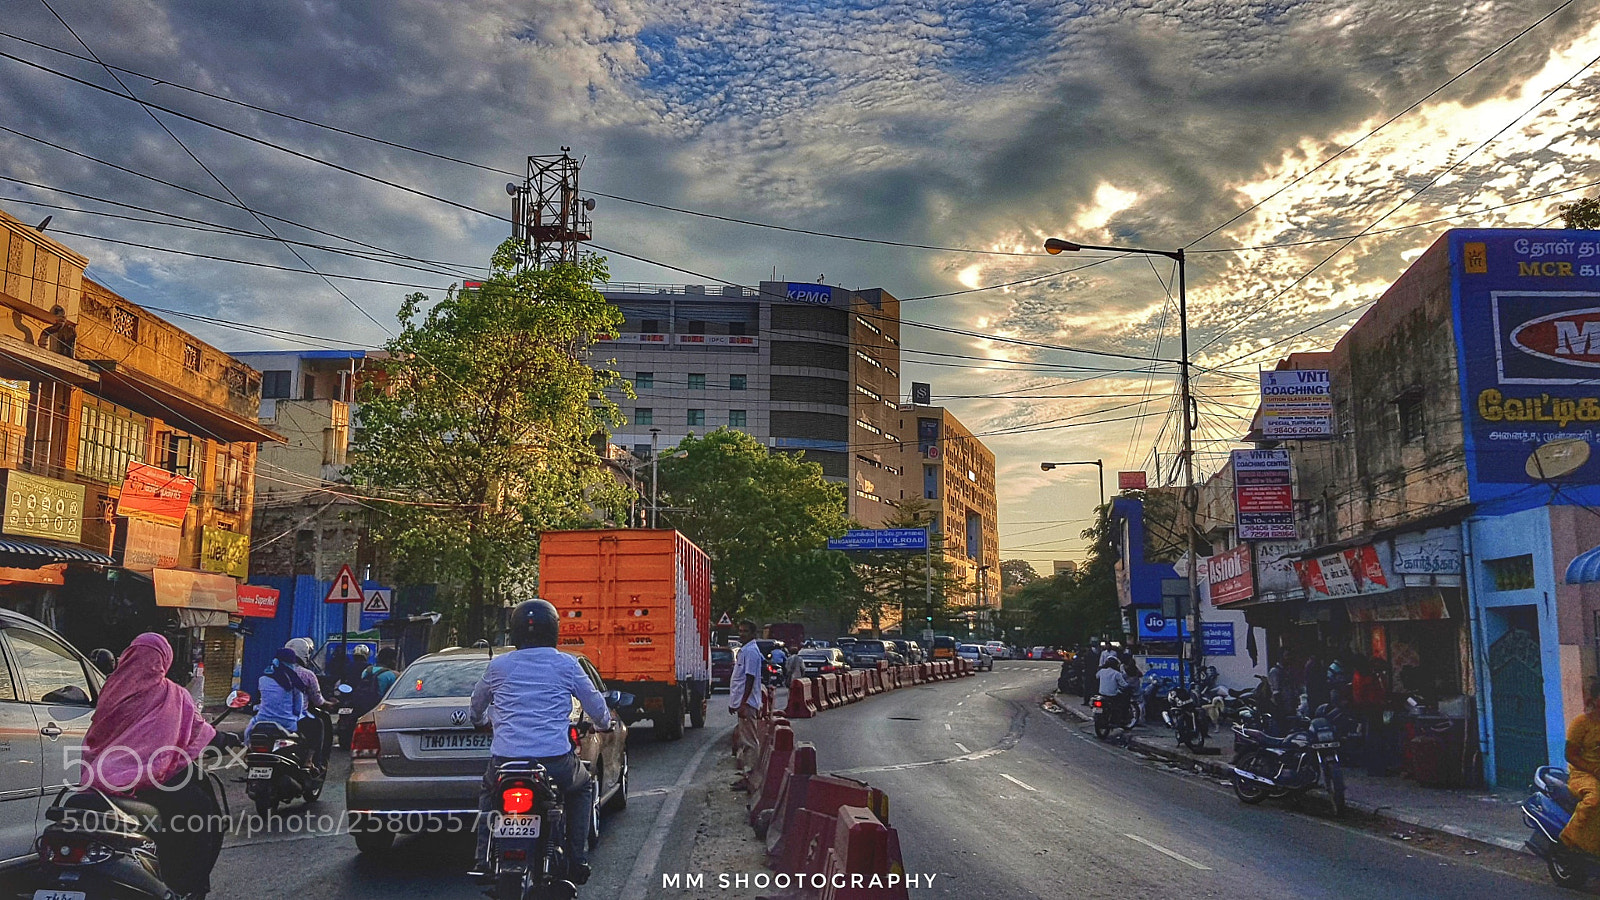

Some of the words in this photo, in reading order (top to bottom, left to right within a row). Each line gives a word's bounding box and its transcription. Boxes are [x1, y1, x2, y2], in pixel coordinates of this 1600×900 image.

[1577, 241, 1600, 258] த
[1517, 261, 1575, 277] MCR
[1579, 264, 1600, 277] க
[786, 290, 830, 304] KPMG
[1263, 385, 1324, 395] COACHING
[1273, 426, 1298, 434] 98406
[1249, 450, 1274, 459] VNTR
[1209, 551, 1243, 584] Ashok
[1146, 617, 1163, 627] Jio
[520, 817, 533, 827] 07
